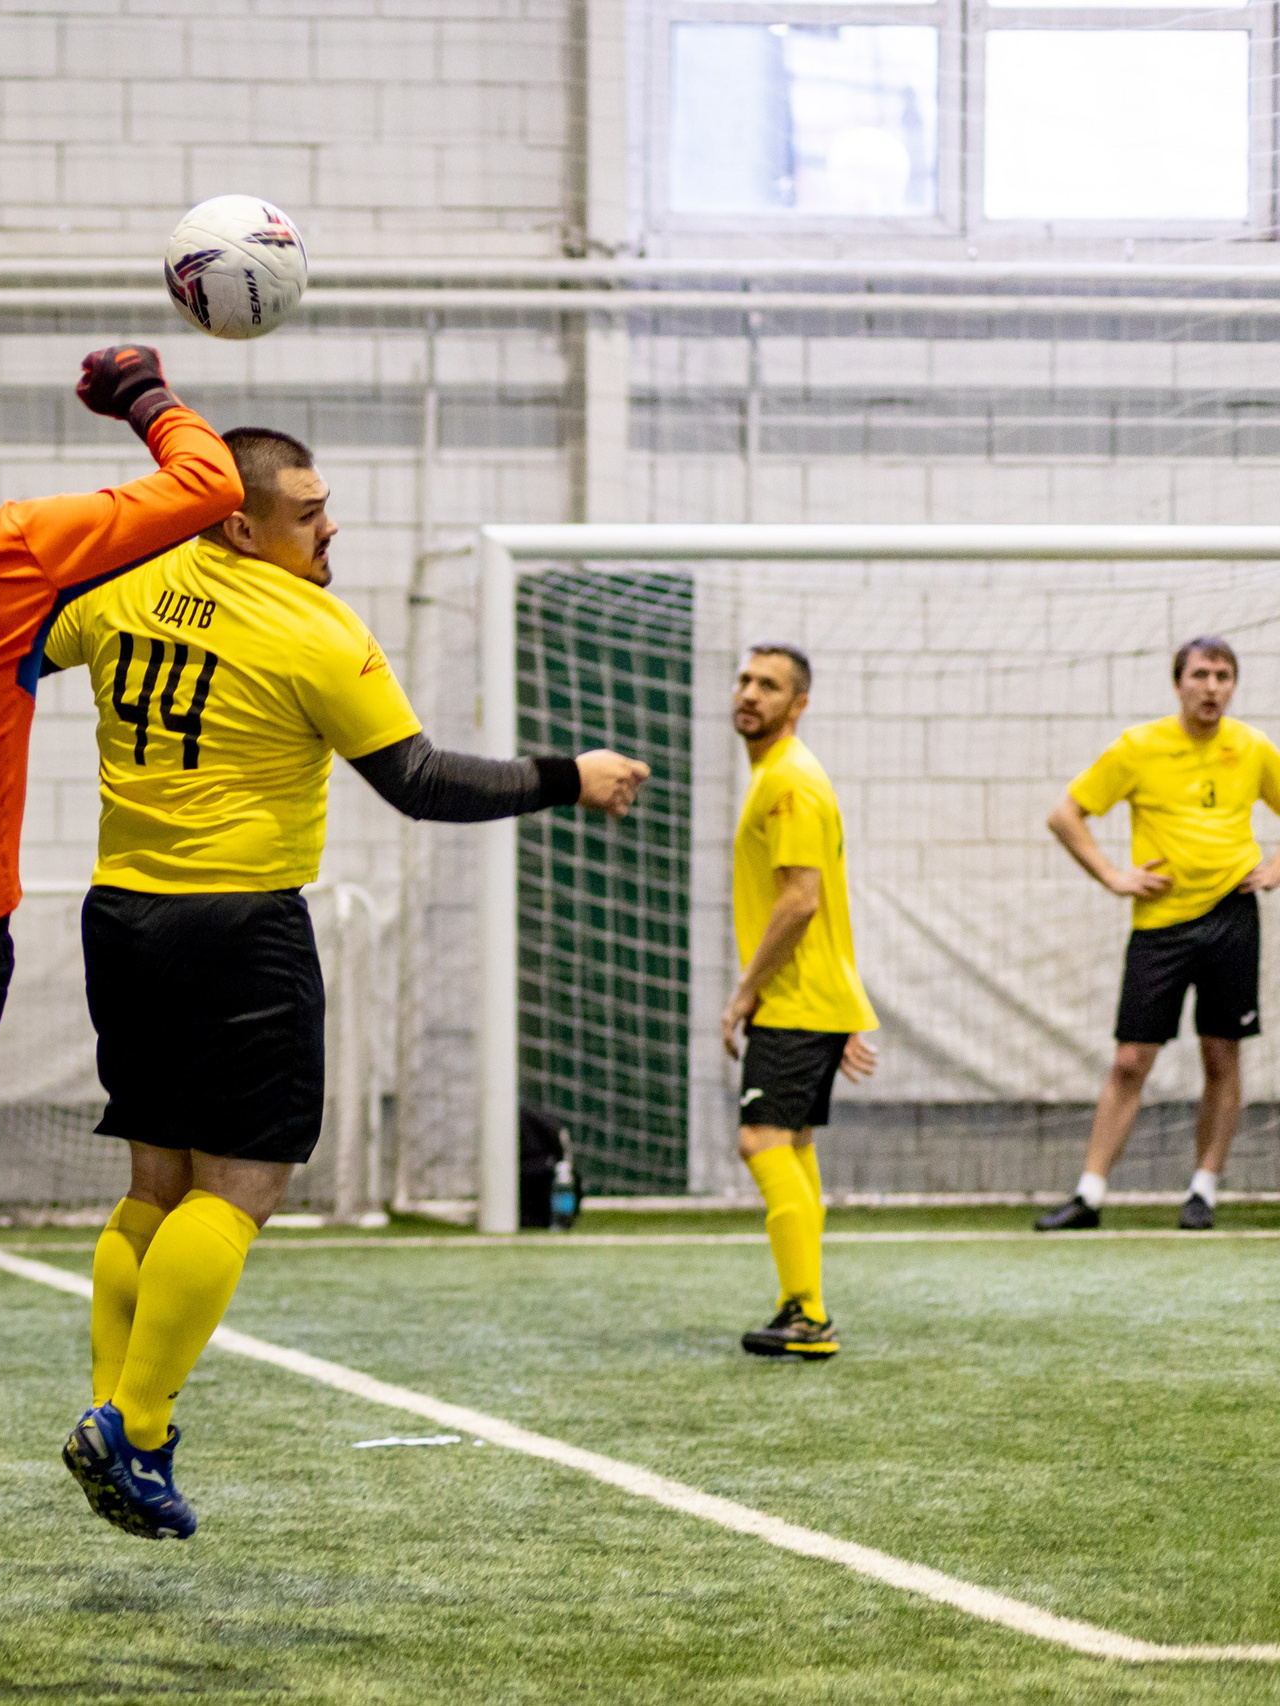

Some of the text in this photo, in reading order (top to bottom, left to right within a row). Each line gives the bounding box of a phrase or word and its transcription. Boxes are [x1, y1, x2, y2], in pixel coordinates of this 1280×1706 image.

[243, 268, 261, 325] DEMIX
[152, 590, 216, 629] ЦДТВ
[112, 630, 218, 770] 44
